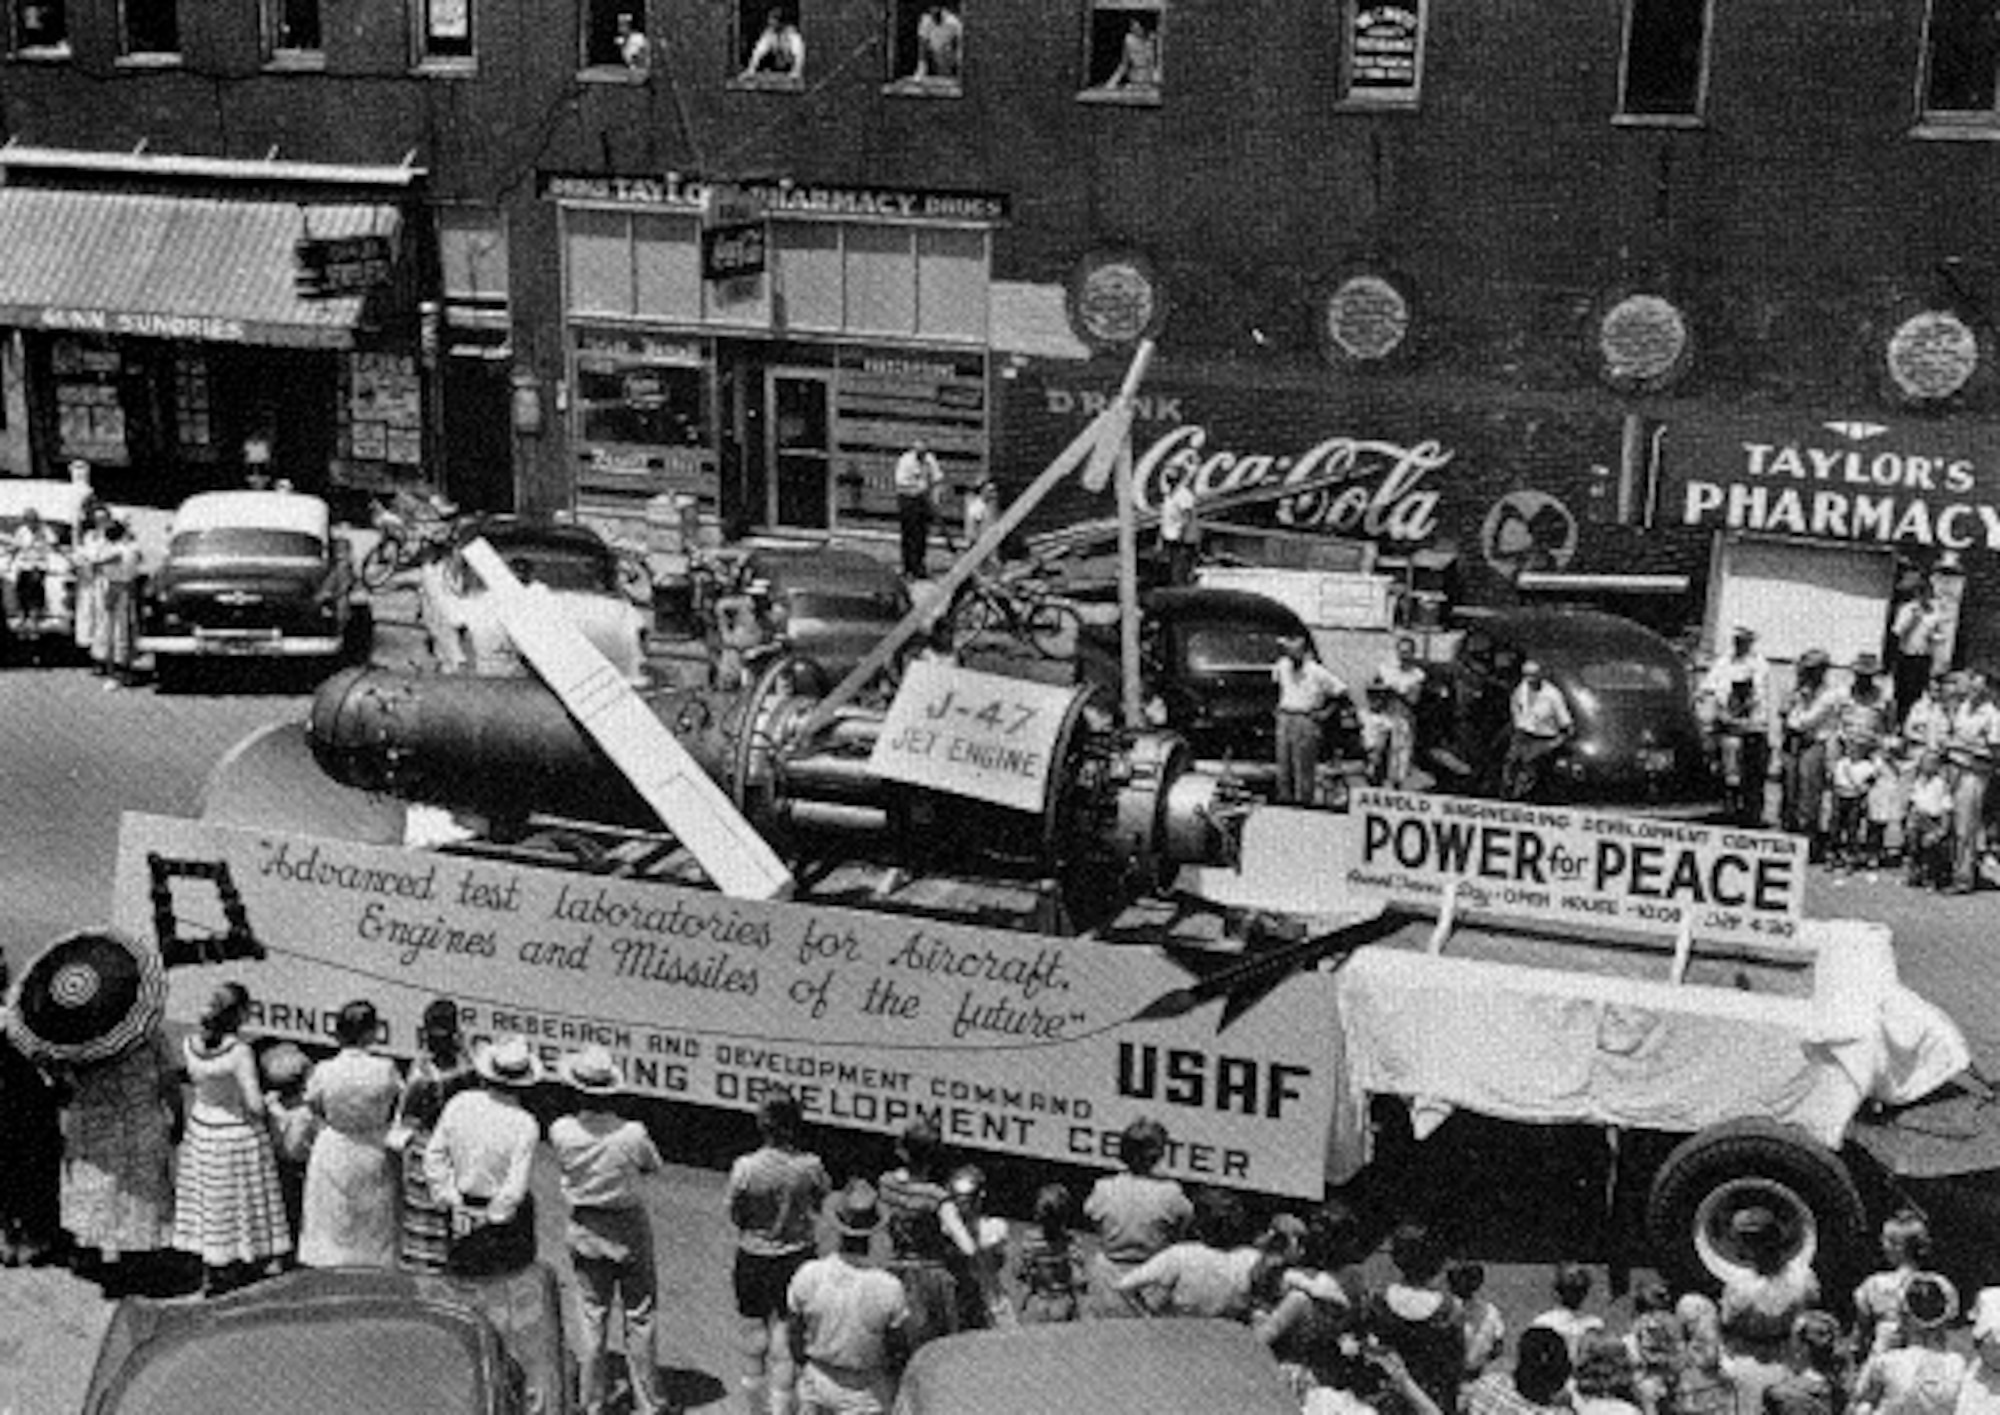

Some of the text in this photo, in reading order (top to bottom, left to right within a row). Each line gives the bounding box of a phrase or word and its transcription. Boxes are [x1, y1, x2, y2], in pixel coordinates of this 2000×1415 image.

[924, 197, 1002, 216] DRUGS
[117, 313, 244, 340] SUNDRIES
[1045, 389, 1183, 423] DRNK
[1741, 441, 1975, 493] TAYLOR'S
[1683, 479, 2000, 549] PHARMACY
[926, 691, 1042, 736] J-47
[892, 728, 1041, 778] JET ENGINE
[1357, 792, 1797, 855] ARNOLD ENGINEERING DEVELOPMENT CENTER
[1363, 813, 1793, 913] POWER for PEACE
[457, 869, 520, 911] test
[551, 884, 771, 949] laboratories
[799, 917, 861, 965] for
[358, 902, 496, 966] Engines
[518, 934, 593, 971] and
[611, 937, 758, 996] Missiles
[788, 969, 834, 1019] of
[861, 977, 920, 1019] the
[246, 1000, 389, 1045] ARNOD
[1069, 1126, 1250, 1179] CETER
[649, 1034, 701, 1059] AND
[716, 1045, 912, 1091] DEVELOPMENT
[930, 1076, 1092, 1119] COMMAND
[1117, 1041, 1312, 1119] USAF
